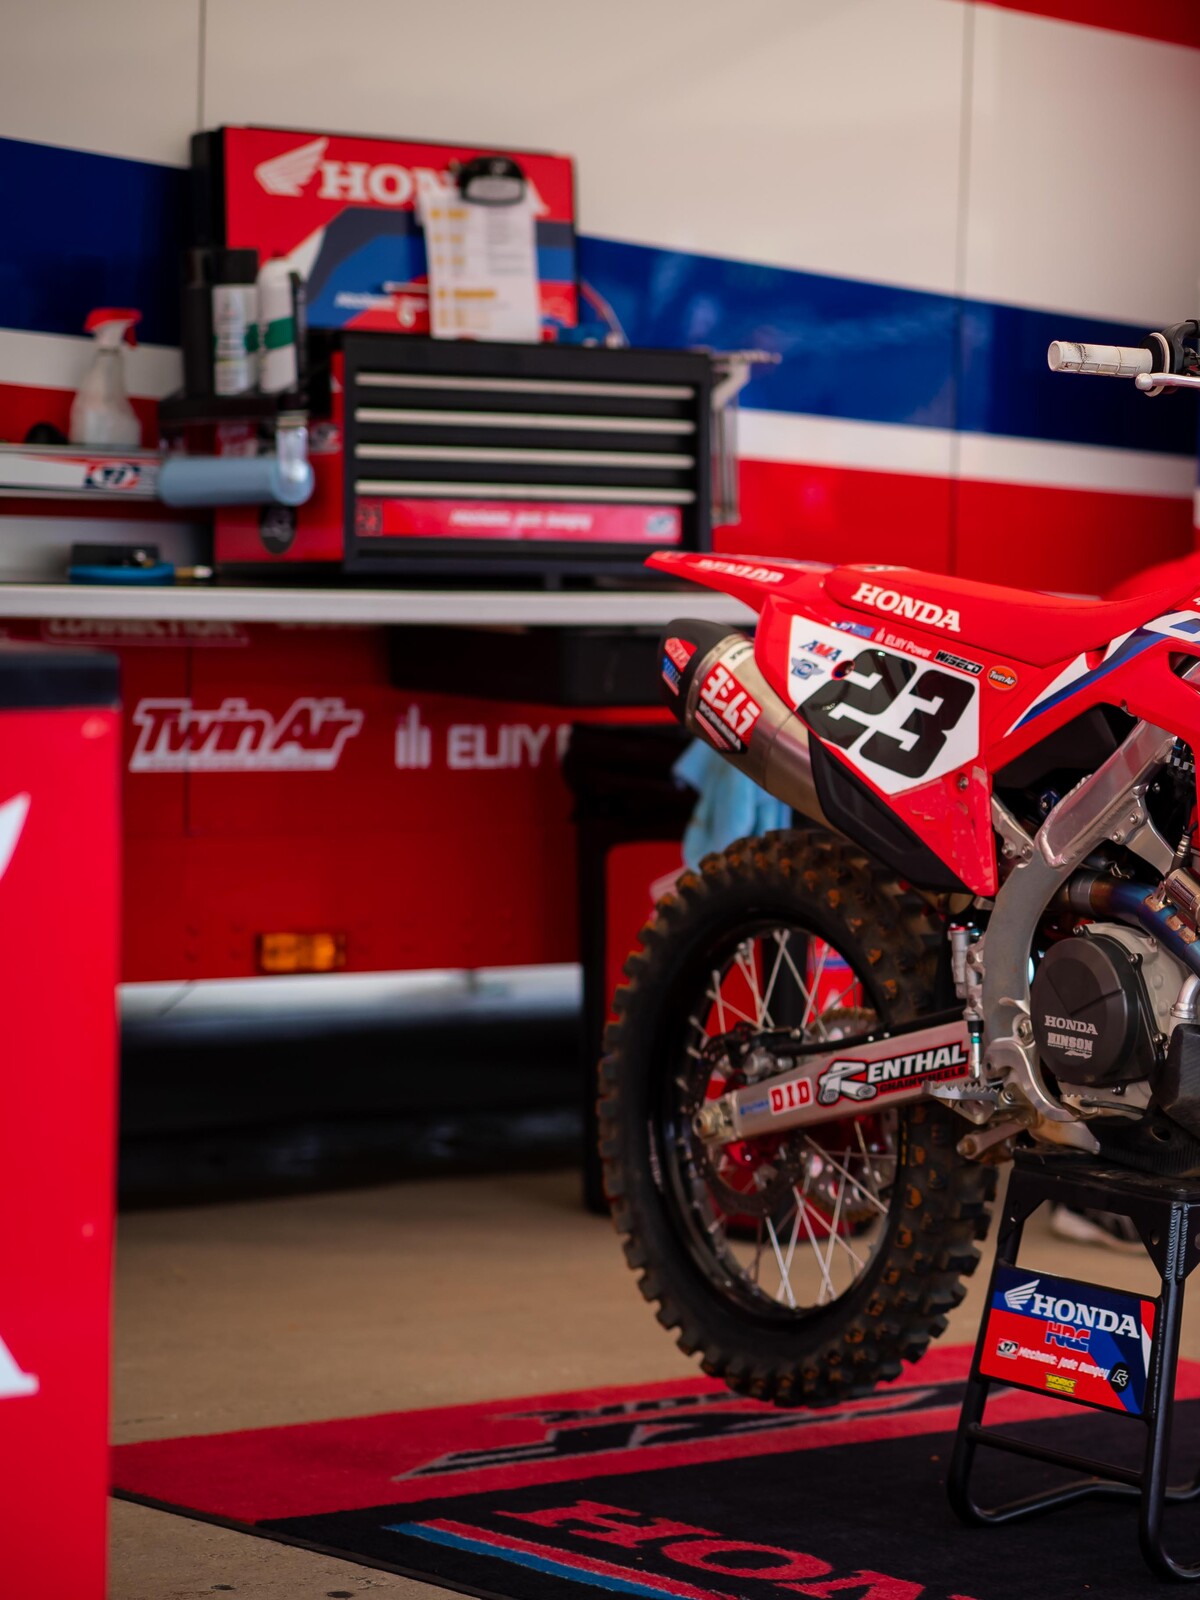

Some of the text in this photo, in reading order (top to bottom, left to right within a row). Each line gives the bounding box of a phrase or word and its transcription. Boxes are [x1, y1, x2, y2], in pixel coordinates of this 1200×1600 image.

[698, 558, 785, 584] DUNLOP
[851, 582, 962, 633] HONDA
[799, 639, 842, 662] AMA
[795, 648, 976, 779] 23
[1044, 1015, 1099, 1036] HONDA
[817, 1044, 967, 1104] RENTHAL
[1030, 1293, 1141, 1339] HONDA
[1045, 1320, 1092, 1353] HRC
